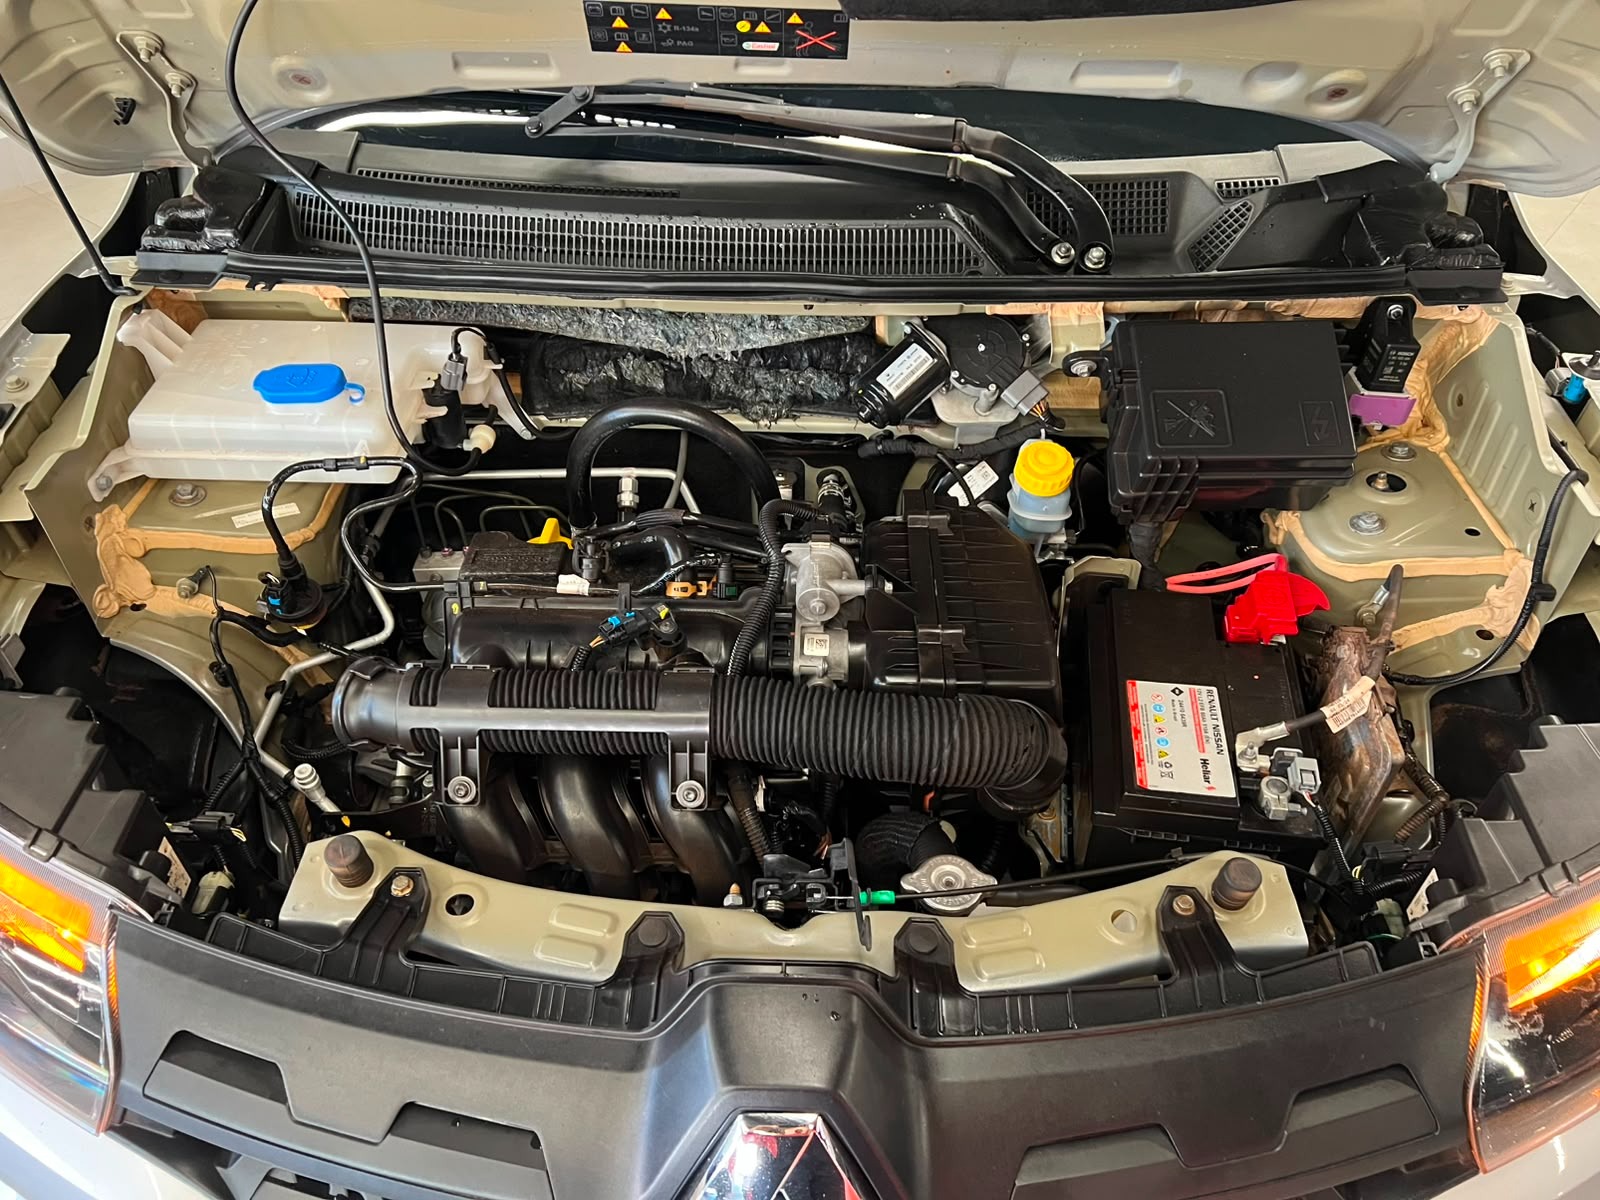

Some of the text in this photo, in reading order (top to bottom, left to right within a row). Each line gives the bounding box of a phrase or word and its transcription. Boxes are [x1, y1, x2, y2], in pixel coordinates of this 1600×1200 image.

[1206, 689, 1225, 756] RENAULT NISSAN
[1200, 758, 1211, 784] Heliar
